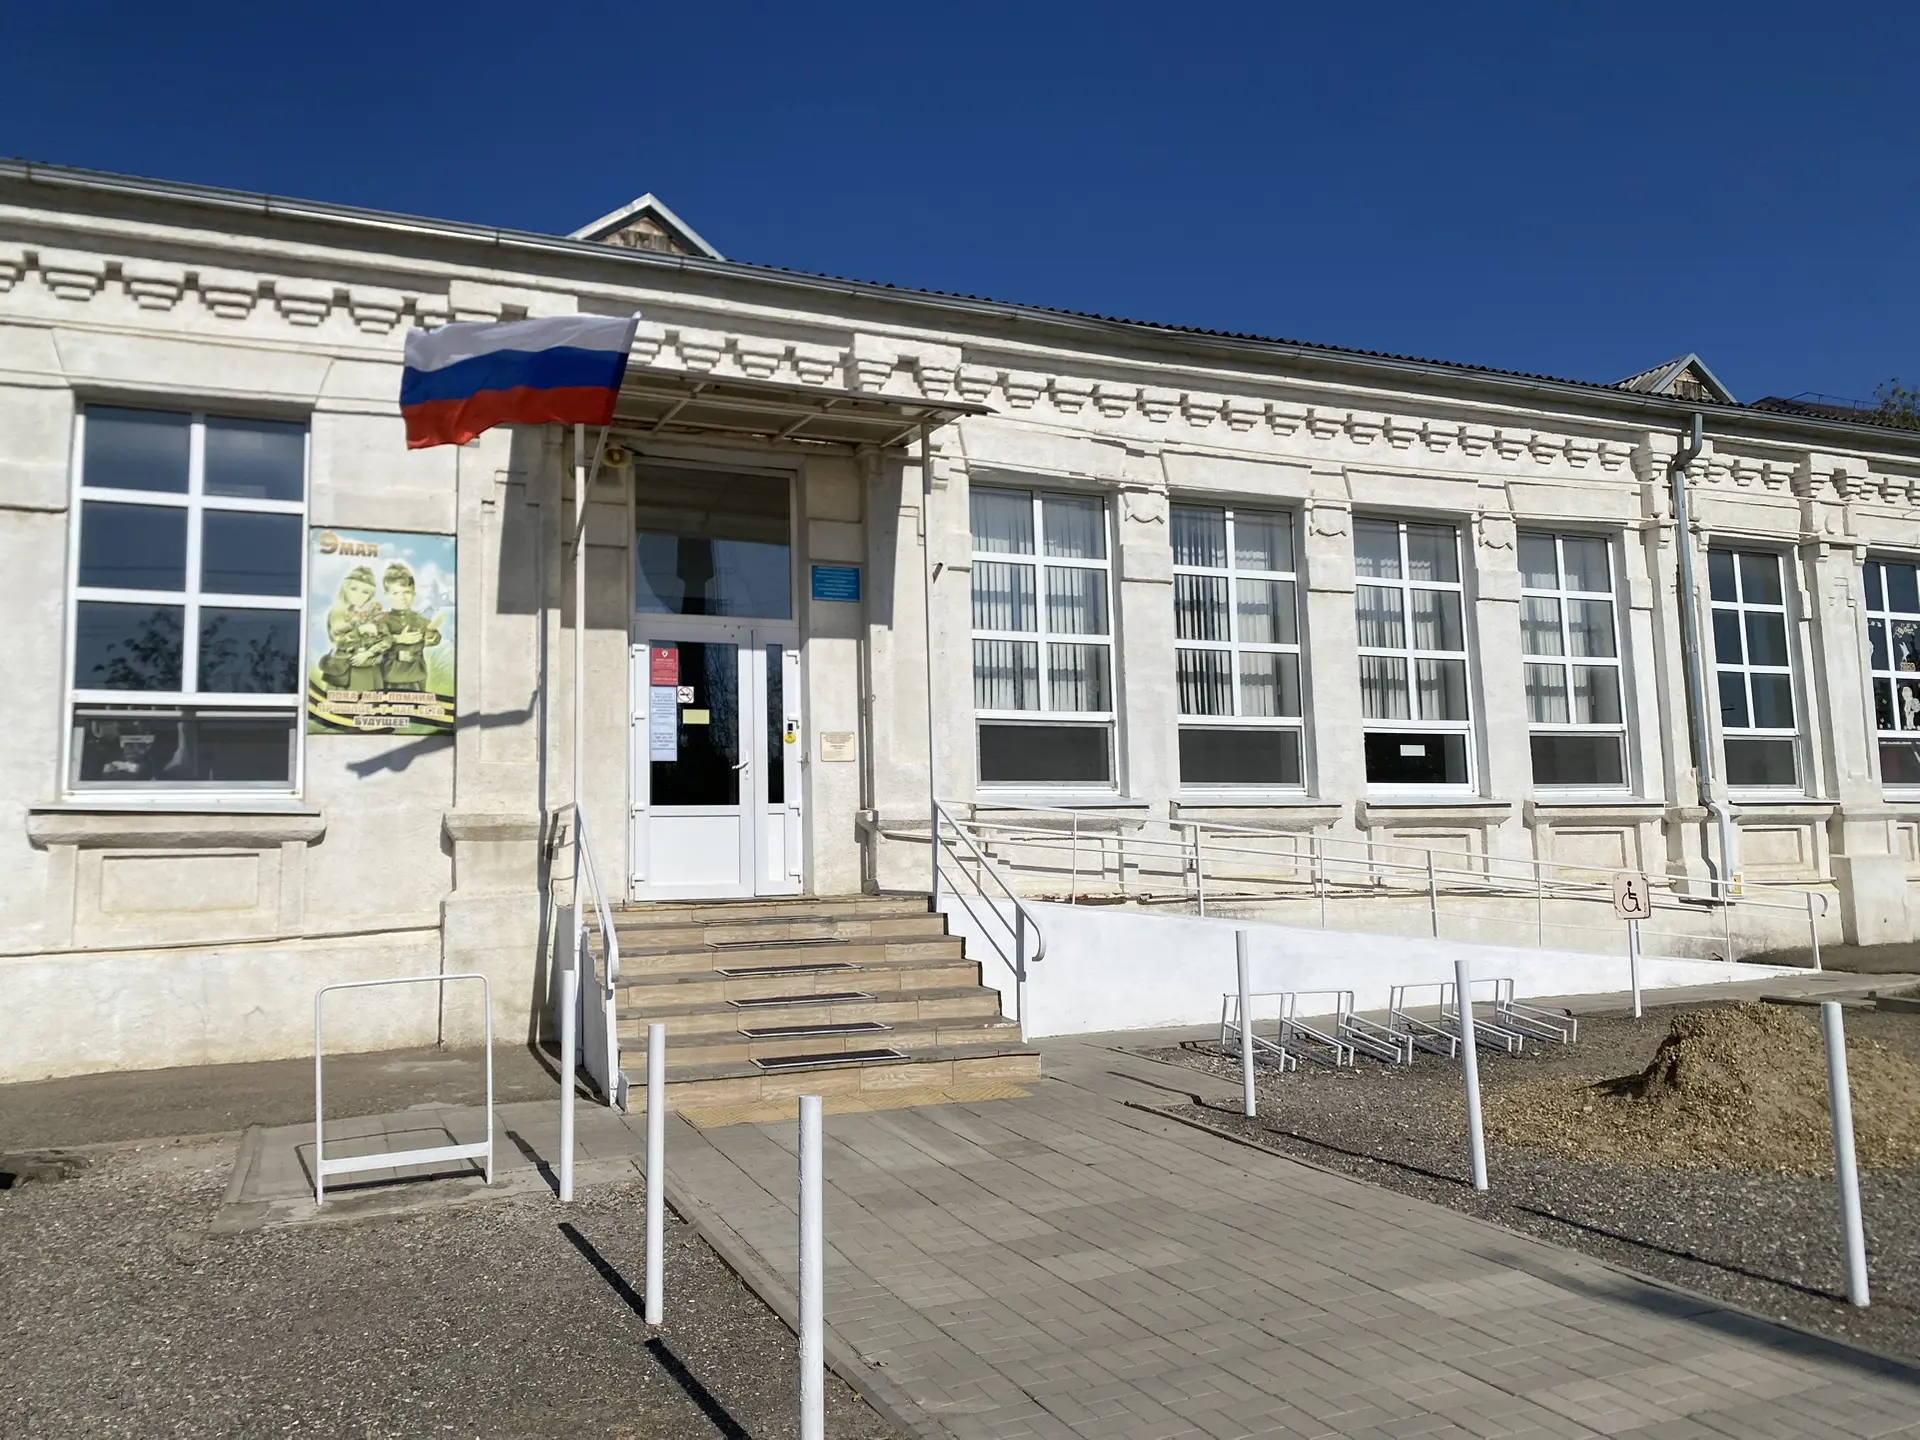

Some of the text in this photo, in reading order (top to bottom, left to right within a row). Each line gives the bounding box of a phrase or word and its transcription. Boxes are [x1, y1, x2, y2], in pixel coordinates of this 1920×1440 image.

[319, 531, 379, 557] 9 МАЯ
[354, 717, 409, 728] БУДУЩЕЕ!
